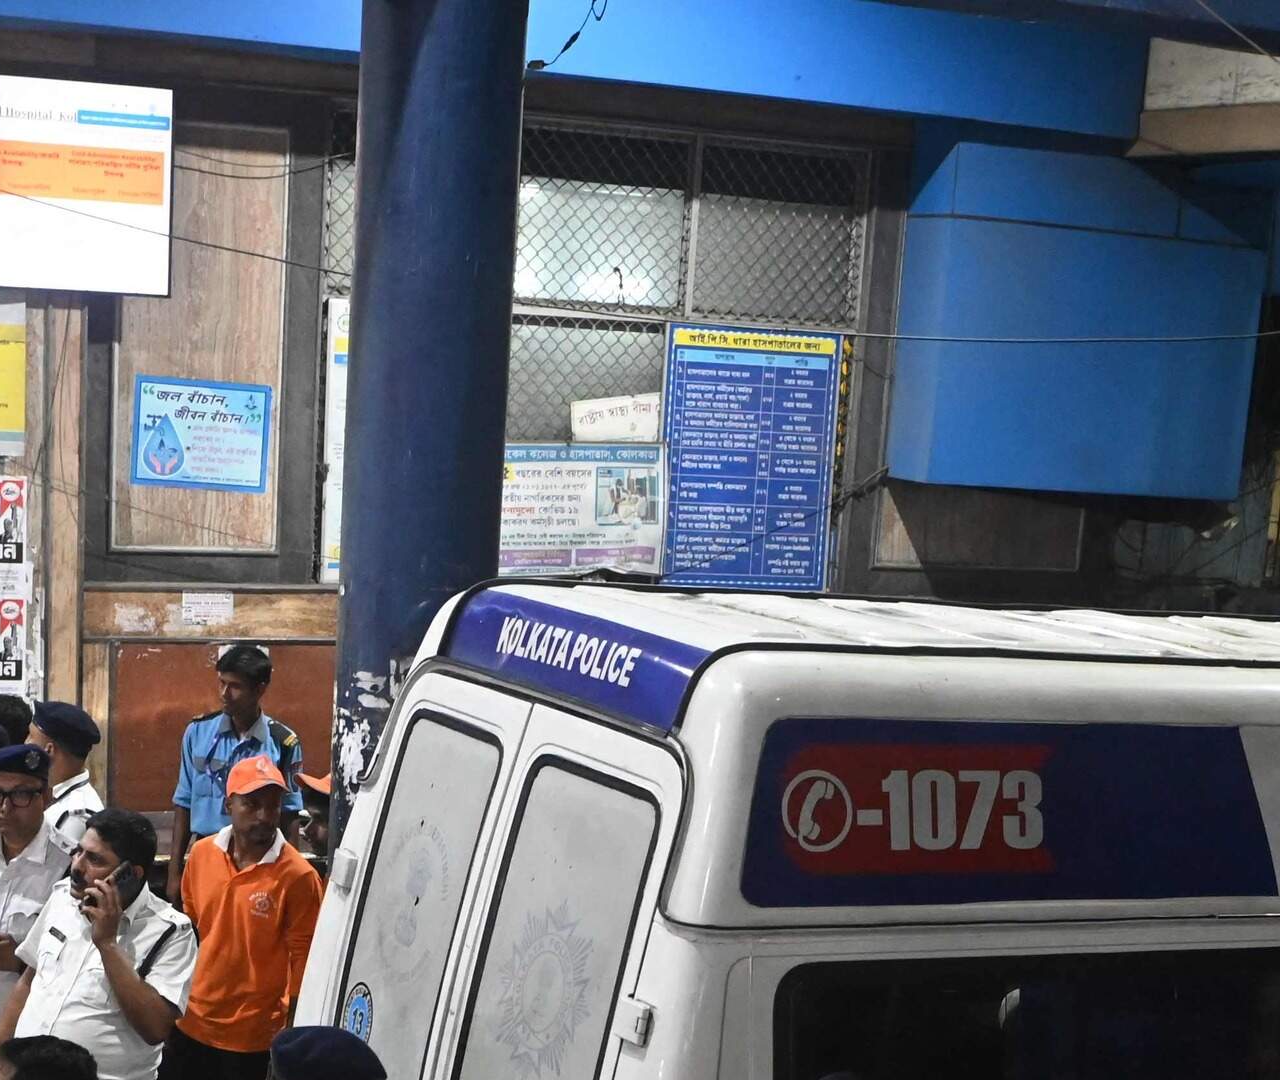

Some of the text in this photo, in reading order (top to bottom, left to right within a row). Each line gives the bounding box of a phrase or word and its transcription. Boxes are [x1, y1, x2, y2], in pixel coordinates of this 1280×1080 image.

[174, 405, 207, 421] জীবন
[496, 616, 642, 688] KOLKATA POLICE
